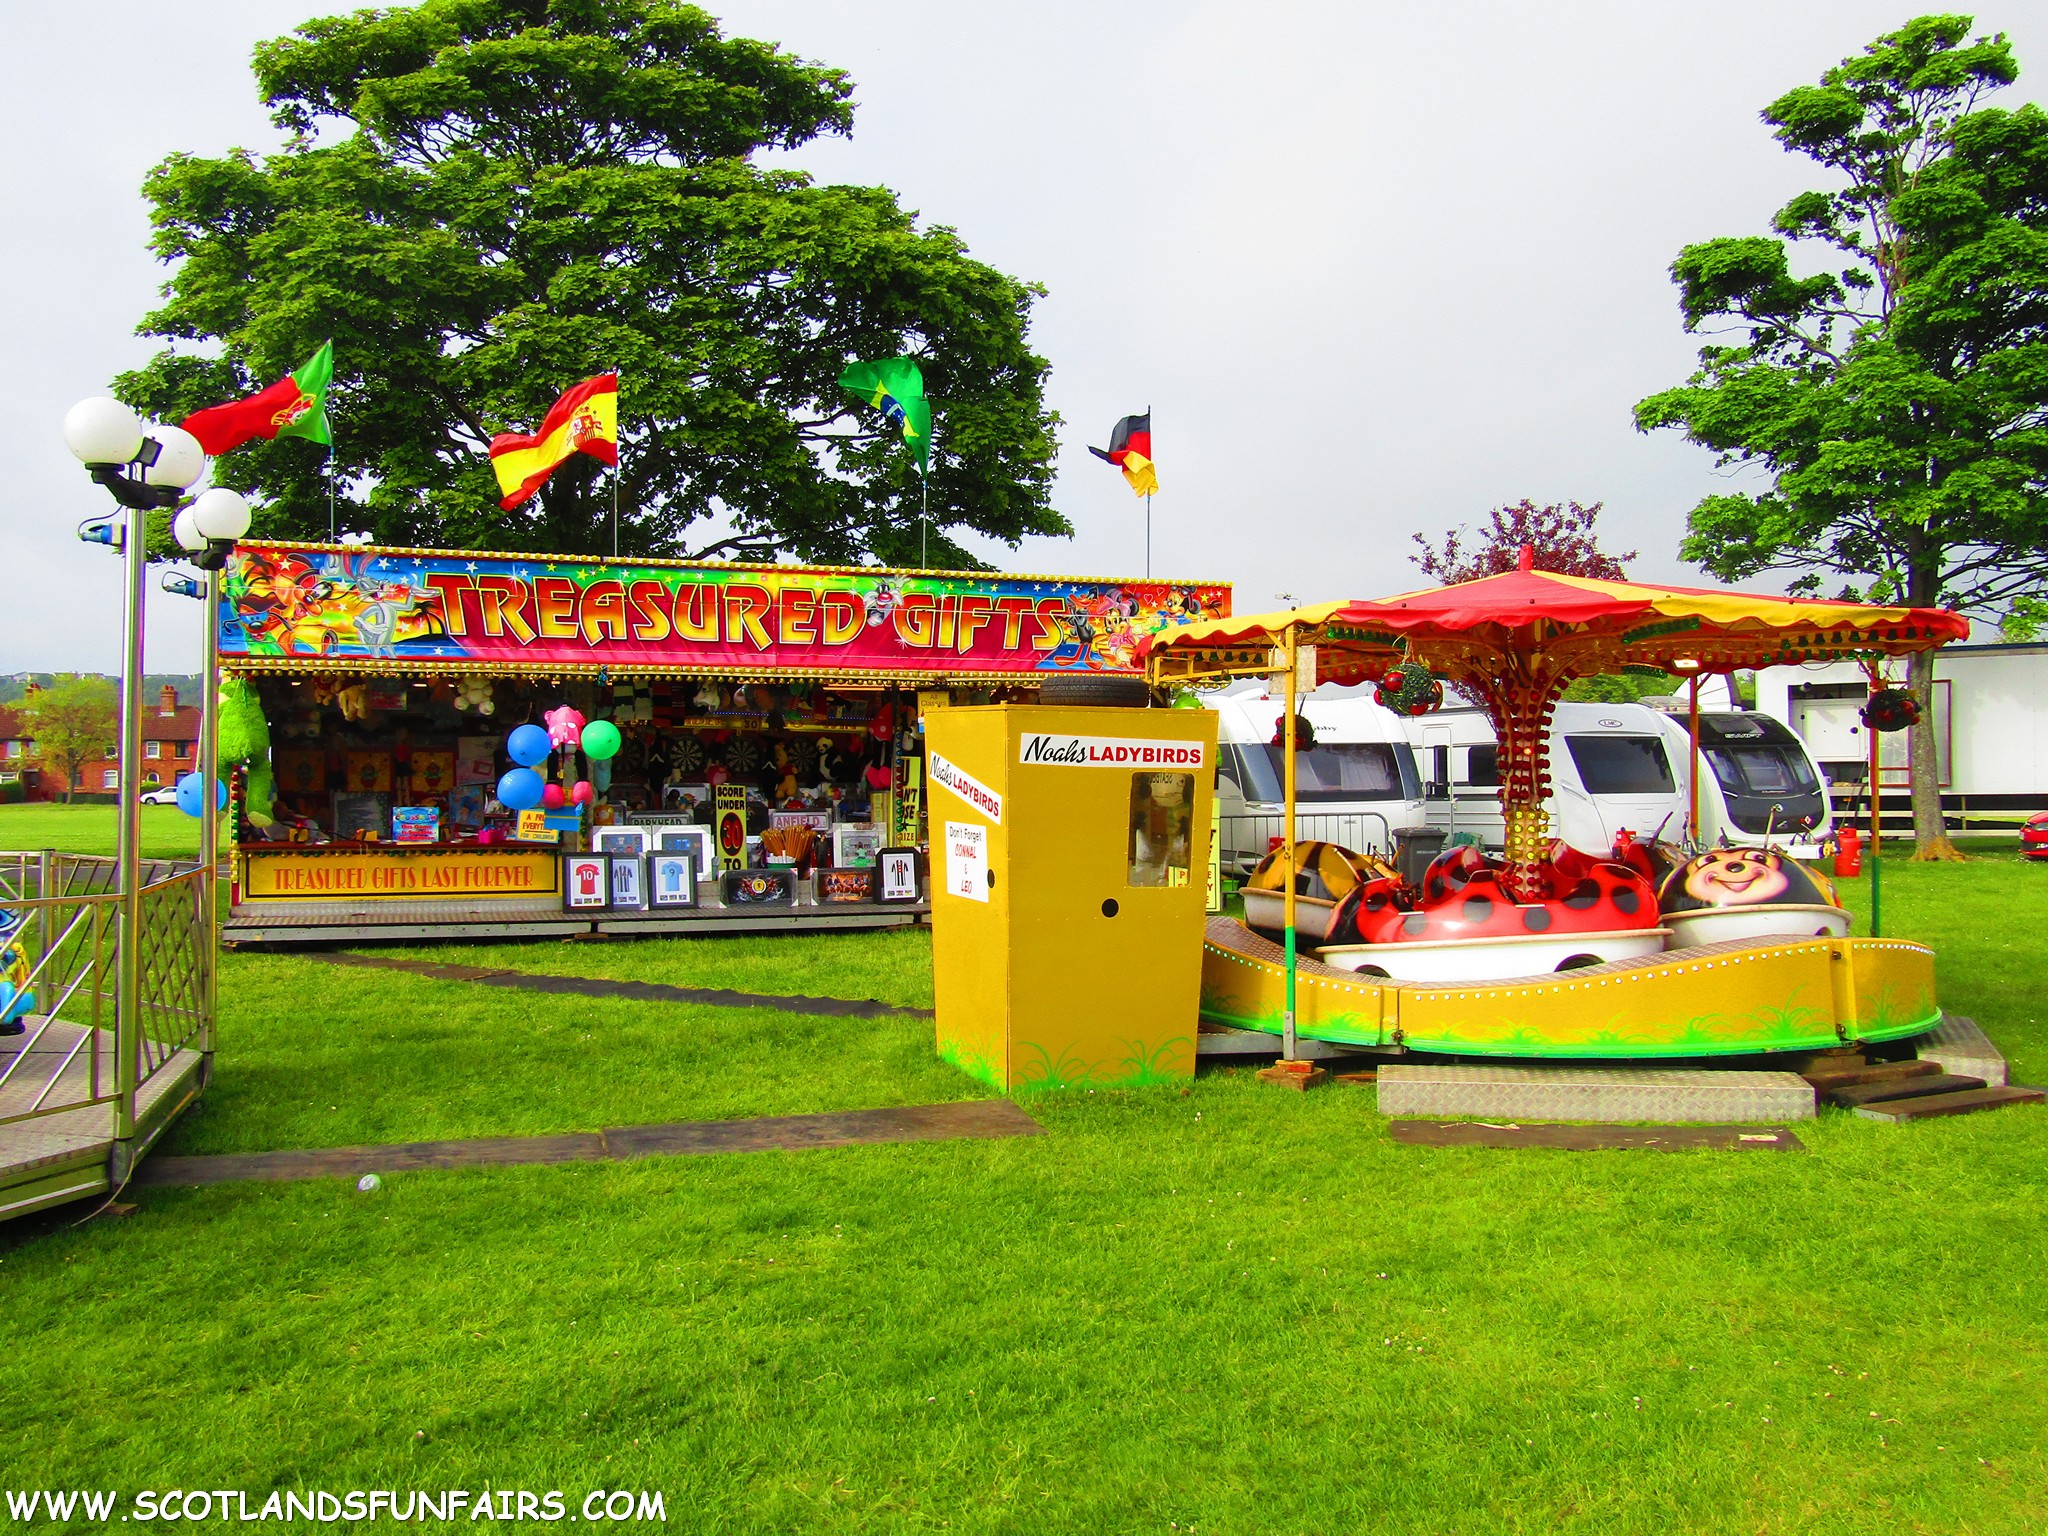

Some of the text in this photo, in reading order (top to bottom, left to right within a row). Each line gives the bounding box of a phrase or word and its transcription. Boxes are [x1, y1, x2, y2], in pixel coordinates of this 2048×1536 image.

[424, 573, 1066, 655] TREASURED GIFTS
[1023, 736, 1202, 766] Noahs LADYBIRDS
[717, 786, 744, 797] SCORE
[930, 756, 1000, 818] Noahs LADYBIRDS
[717, 799, 745, 810] UNDER
[775, 816, 821, 829] ANFIELD
[722, 818, 742, 850] 30
[949, 825, 982, 844] Don't Forget
[669, 867, 675, 877] 9
[723, 858, 742, 870] TO
[274, 865, 534, 890] TREASURED GIFTS LAST FOREVER
[582, 871, 594, 881] 10
[960, 879, 973, 895] LEO
